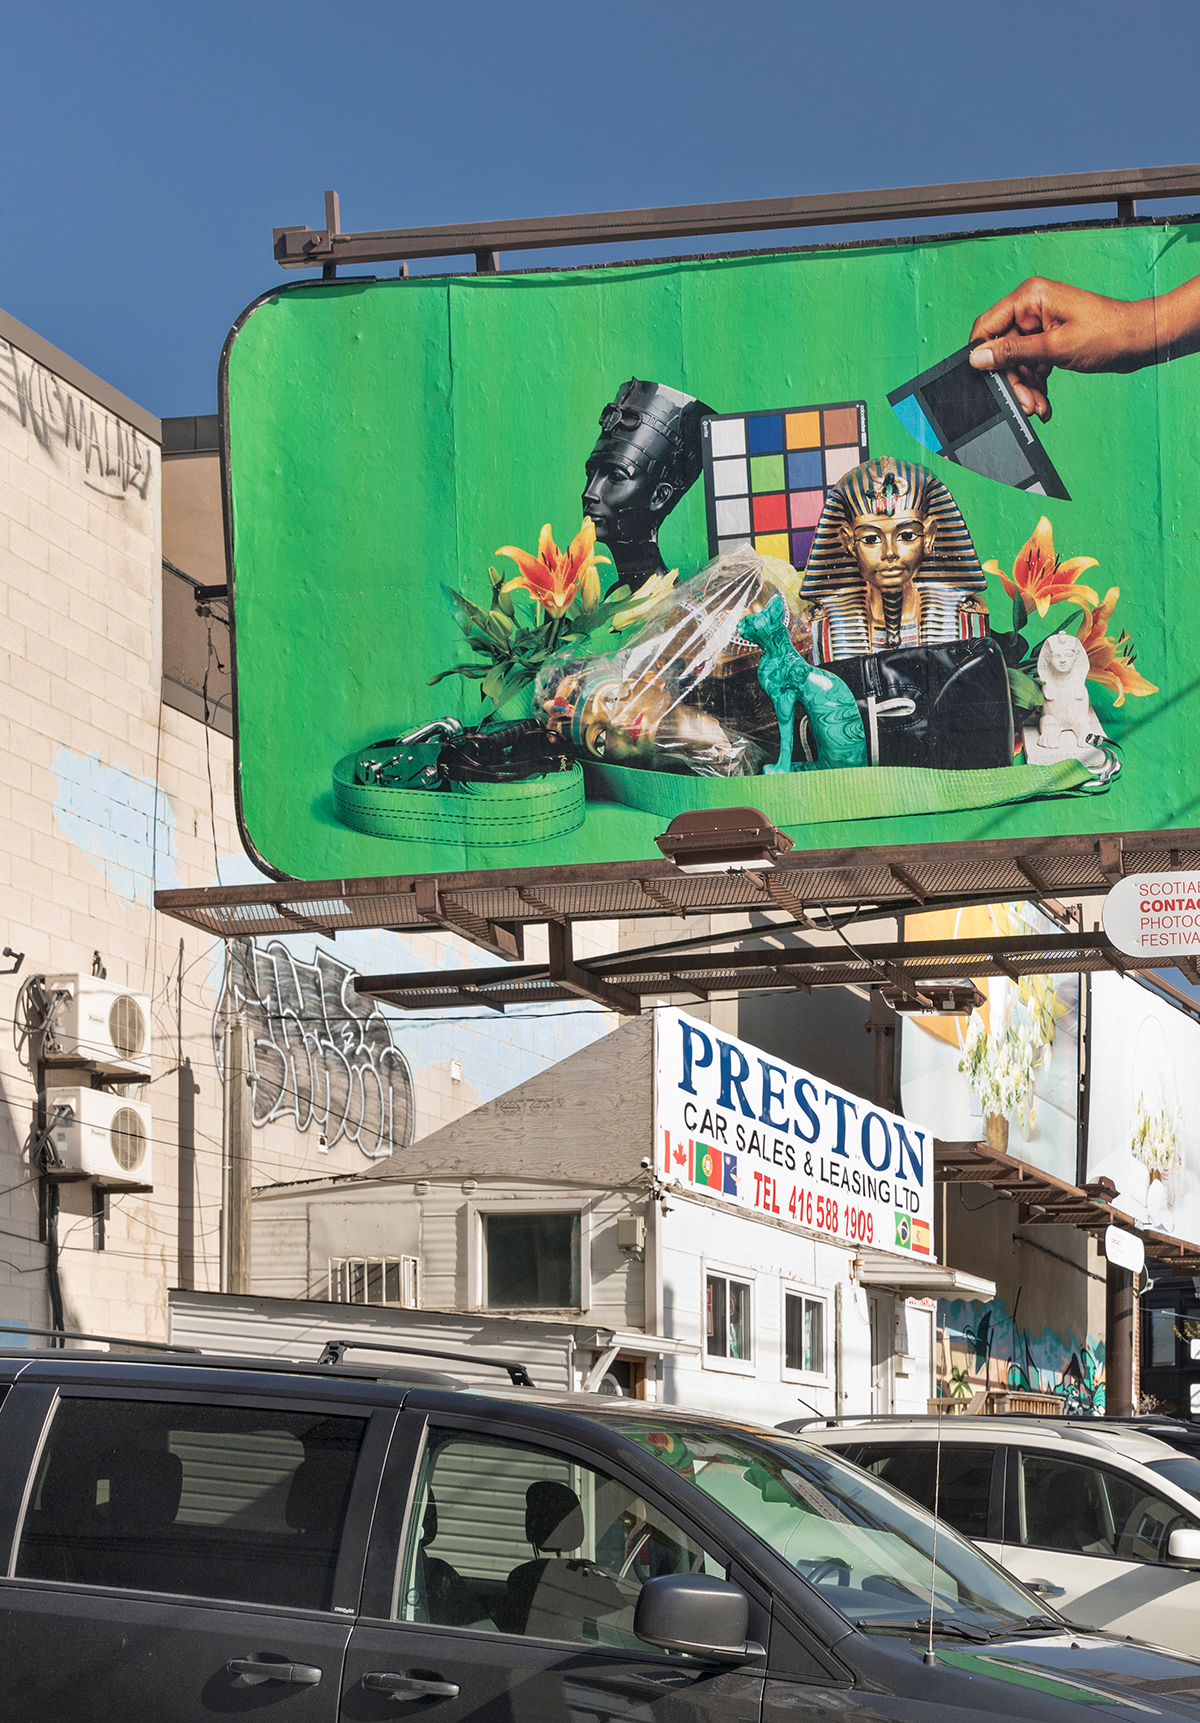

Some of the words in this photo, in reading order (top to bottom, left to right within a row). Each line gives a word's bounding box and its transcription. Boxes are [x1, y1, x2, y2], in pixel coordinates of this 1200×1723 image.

[677, 1018, 925, 1188] PRESTON
[684, 1102, 728, 1145] CAR
[735, 1123, 796, 1171] SALES
[803, 1151, 814, 1177] &
[820, 1157, 891, 1204] LEASING
[894, 1187, 920, 1214] LTD
[754, 1170, 780, 1214] TEL
[788, 1185, 813, 1225] 416
[816, 1195, 839, 1233] 588
[844, 1203, 874, 1244] 1909
